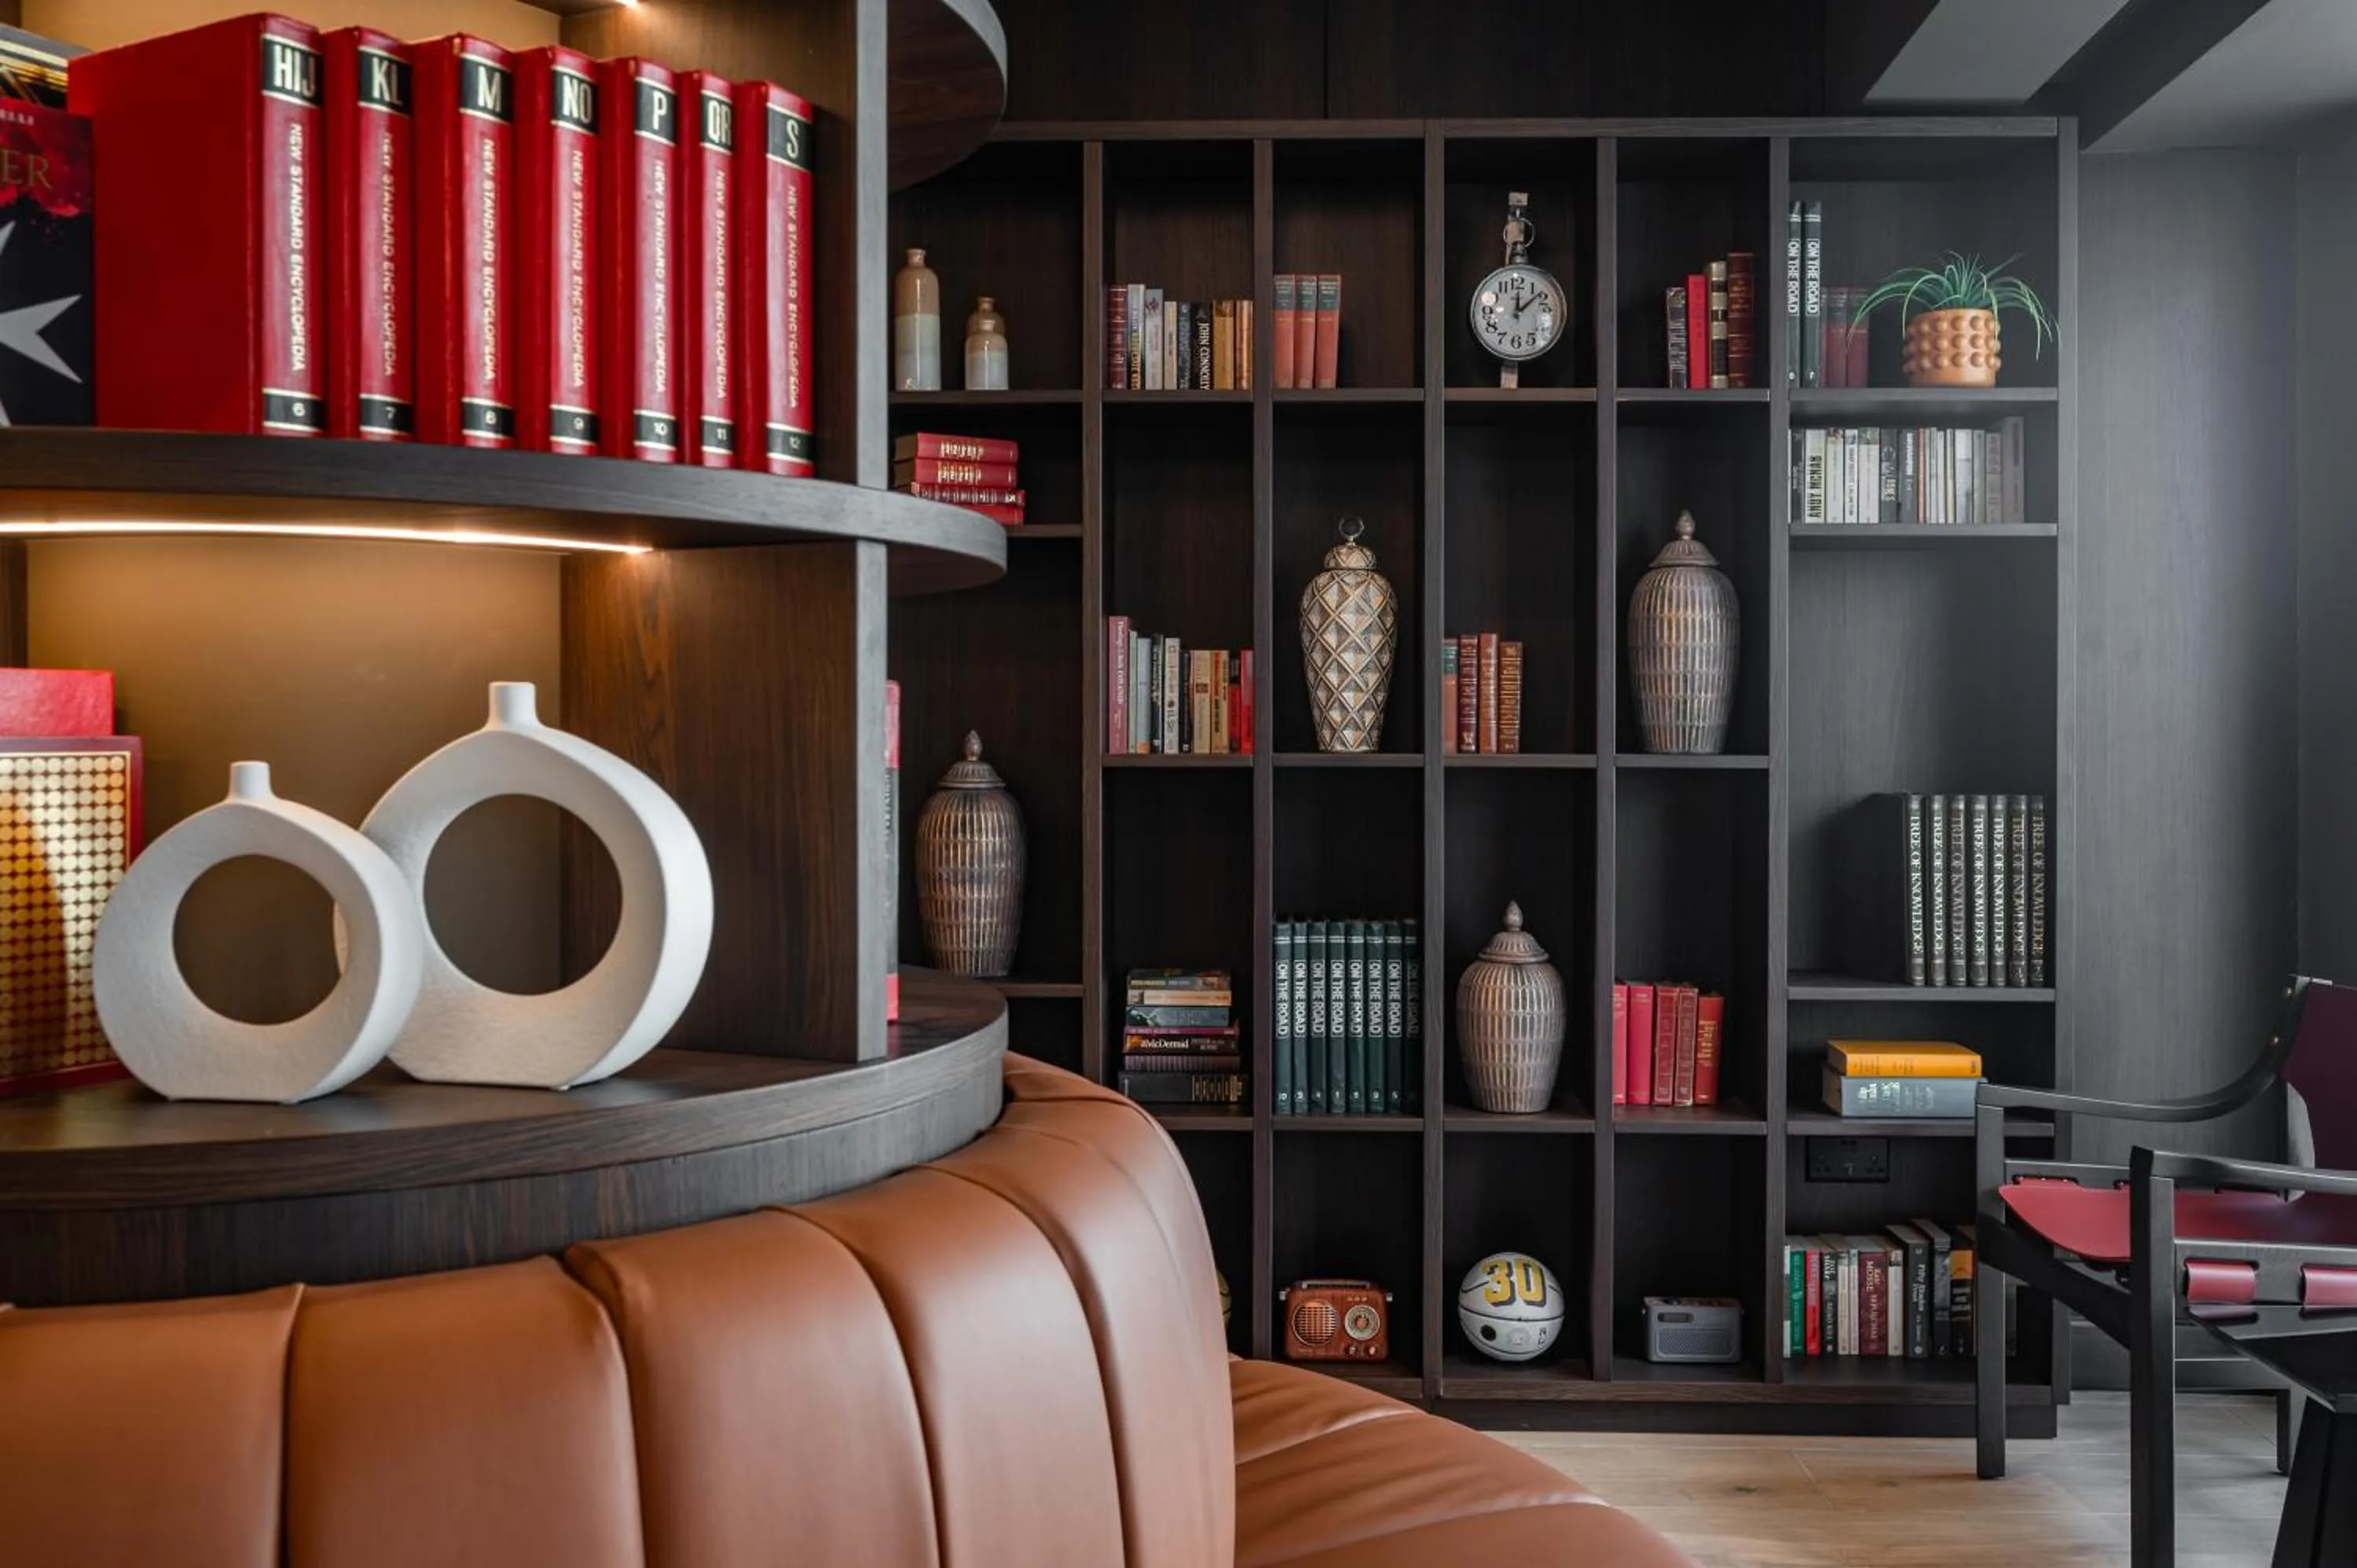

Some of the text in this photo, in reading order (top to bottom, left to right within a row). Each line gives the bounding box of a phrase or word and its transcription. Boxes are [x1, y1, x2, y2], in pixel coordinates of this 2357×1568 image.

[273, 44, 317, 97] HIJ
[372, 57, 403, 106] KL
[477, 65, 501, 112] M
[562, 75, 592, 124] NO
[652, 90, 668, 130] P
[707, 99, 731, 146] QR
[786, 119, 800, 159] S
[382, 174, 395, 257] STANDARD
[290, 124, 306, 372] NEW STANDARD ENCYCLOPEDIA
[482, 139, 496, 380] NEW STANDARD ENCYCLOPEDIA
[571, 150, 585, 387] NEW STANDARD ENCYCLOPEDIA
[654, 159, 666, 392] NEW STANDARD ENCYCLOPEDIA
[716, 170, 727, 399] NEW STANDARD ENCYCLOPEDIA
[787, 185, 800, 408] NEW STANDARD ENCYCLOPEDIA
[1498, 281, 1508, 294] 11
[1510, 277, 1525, 290] 12
[1530, 282, 1534, 294] 1
[1538, 291, 1549, 306] 2
[1787, 241, 1798, 313] ON THE ROAD
[1807, 241, 1818, 313] ON THE ROAD
[383, 262, 397, 376] ENCYCLOPEDIA
[1486, 321, 1497, 334] 8
[1497, 332, 1507, 345] 7
[1511, 335, 1522, 349] 6
[1526, 332, 1536, 346] 5
[1198, 323, 1210, 390] JOHN CONNOLLY
[292, 402, 306, 416] 6
[385, 406, 397, 419] 7
[574, 417, 585, 430] 9
[654, 422, 668, 436] 10
[717, 427, 727, 441] 11
[1808, 493, 1822, 518] ANDY
[1911, 816, 1923, 954] TREE OF KNOWLEDGE
[1934, 852, 1942, 868] OF
[1974, 818, 1985, 956] TREE OF KNOWLEDGE
[1993, 818, 2004, 956] TREE OF KNOWLEDGE
[1934, 873, 1943, 955] KNOWLEDGE
[1277, 964, 1288, 1035] ON THE ROAD
[1295, 963, 1305, 1033] ON THE ROAD
[1313, 963, 1324, 1033] ON THE ROAD
[1332, 963, 1343, 1033] ON THE ROAD
[1351, 963, 1361, 1033] ON THE ROAD
[1369, 963, 1381, 1034] ON THE ROAD
[1389, 963, 1400, 1034] ON THE ROAD
[1483, 1258, 1547, 1307] 30
